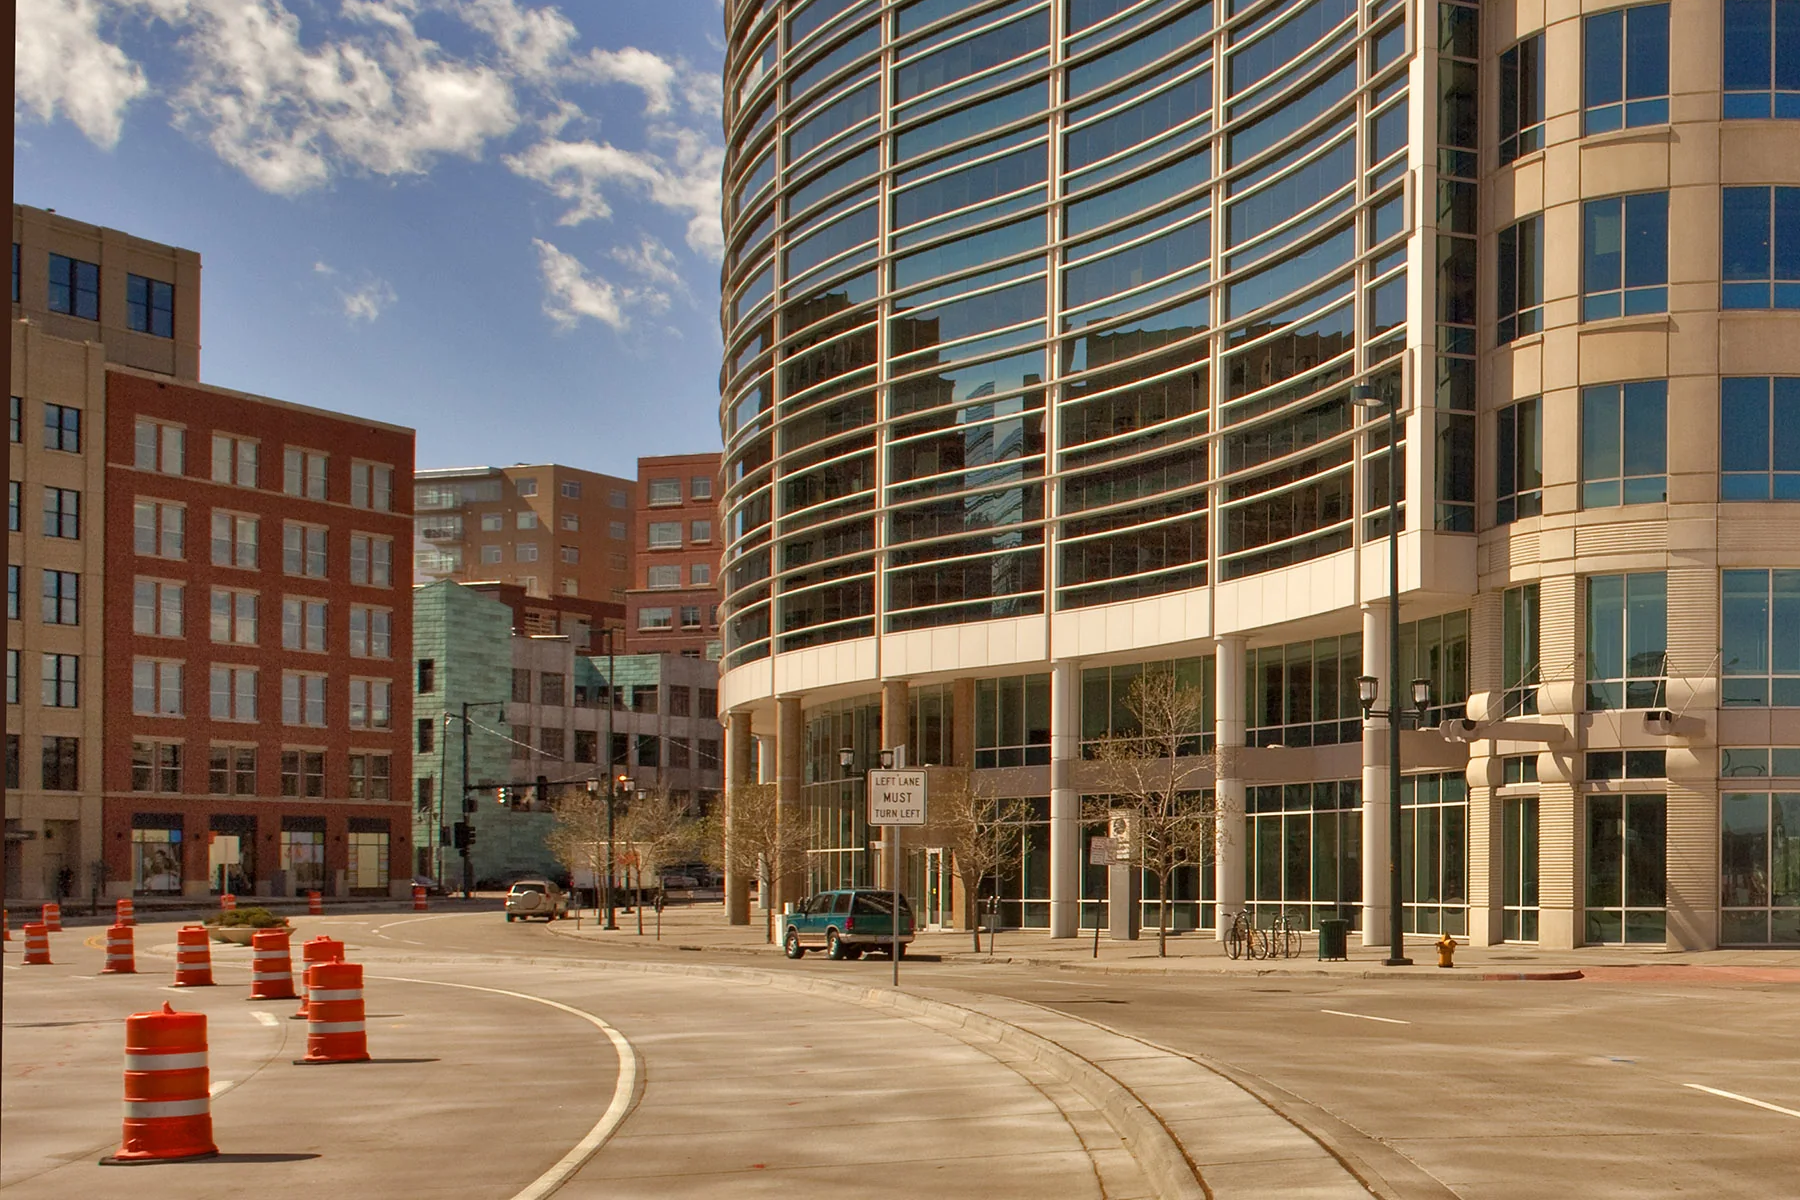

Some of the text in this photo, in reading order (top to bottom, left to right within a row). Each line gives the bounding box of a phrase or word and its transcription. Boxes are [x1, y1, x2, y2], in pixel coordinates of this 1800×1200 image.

[875, 777, 920, 786] LEFT LANE
[883, 792, 912, 803] MUST
[875, 809, 920, 818] TURN LEFT
